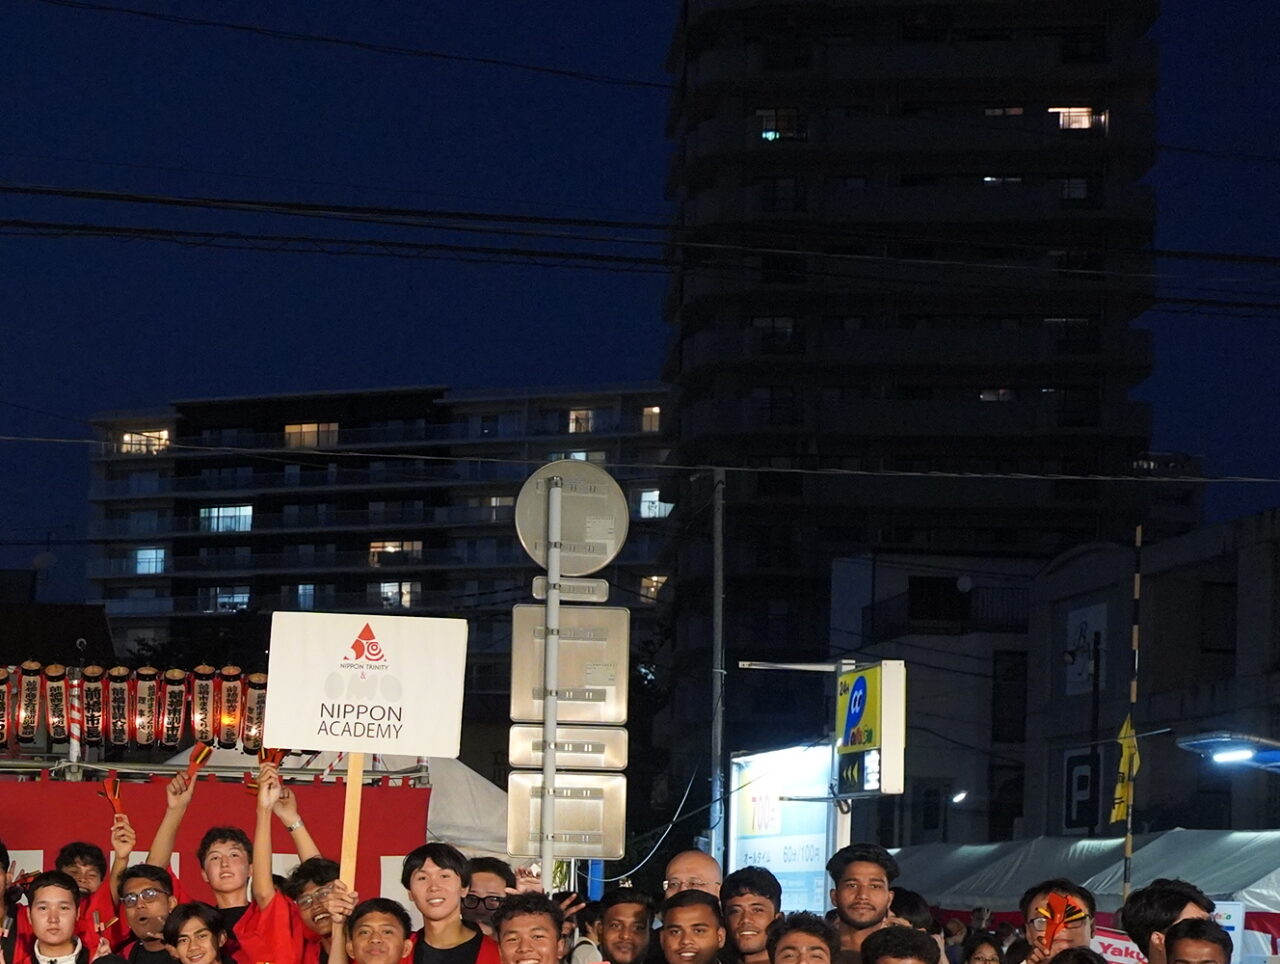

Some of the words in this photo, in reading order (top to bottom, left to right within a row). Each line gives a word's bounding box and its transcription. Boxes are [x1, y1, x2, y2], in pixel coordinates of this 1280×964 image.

[84, 687, 102, 739] 前橋市長
[317, 720, 403, 740] ACADEMY
[320, 703, 403, 721] NIPPON
[1071, 765, 1092, 821] P
